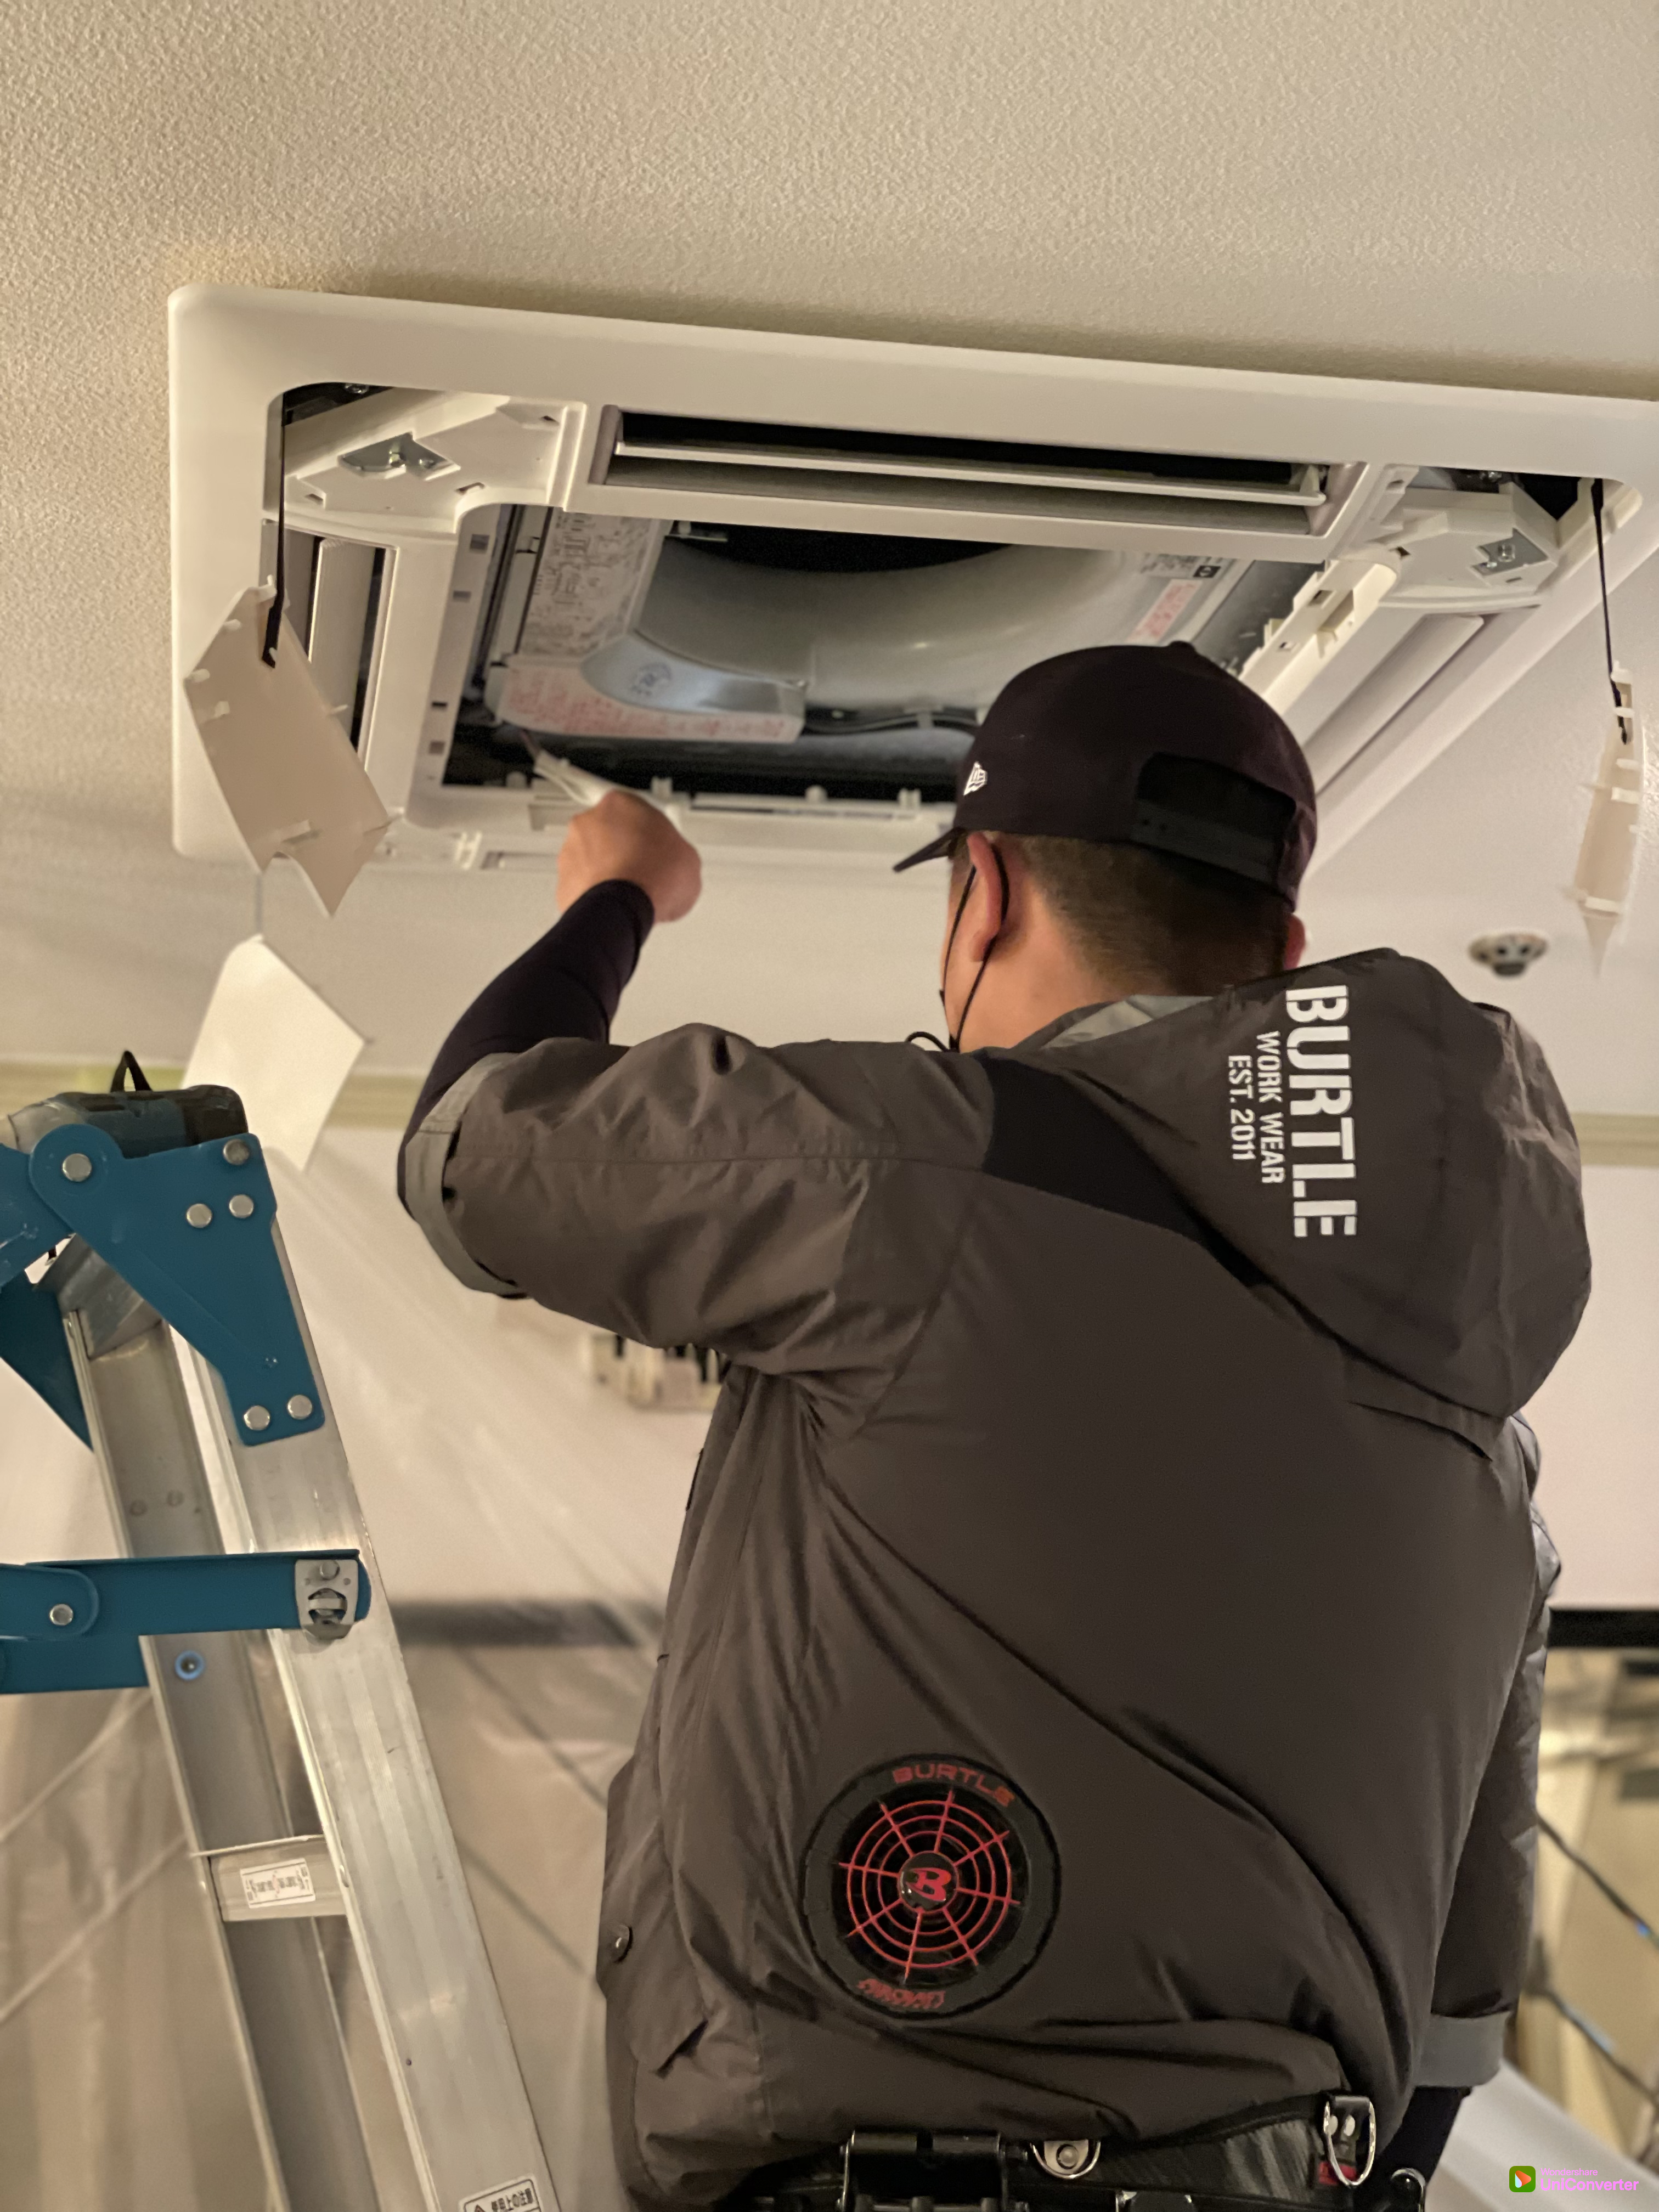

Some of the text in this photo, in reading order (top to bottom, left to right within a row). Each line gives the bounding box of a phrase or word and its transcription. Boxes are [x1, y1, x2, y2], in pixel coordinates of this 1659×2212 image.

[1228, 1055, 1256, 1160] EST. 2011
[1256, 1030, 1285, 1184] WORK WEAR
[1285, 985, 1358, 1238] BURTLE
[893, 1763, 1015, 1807] BURTLE
